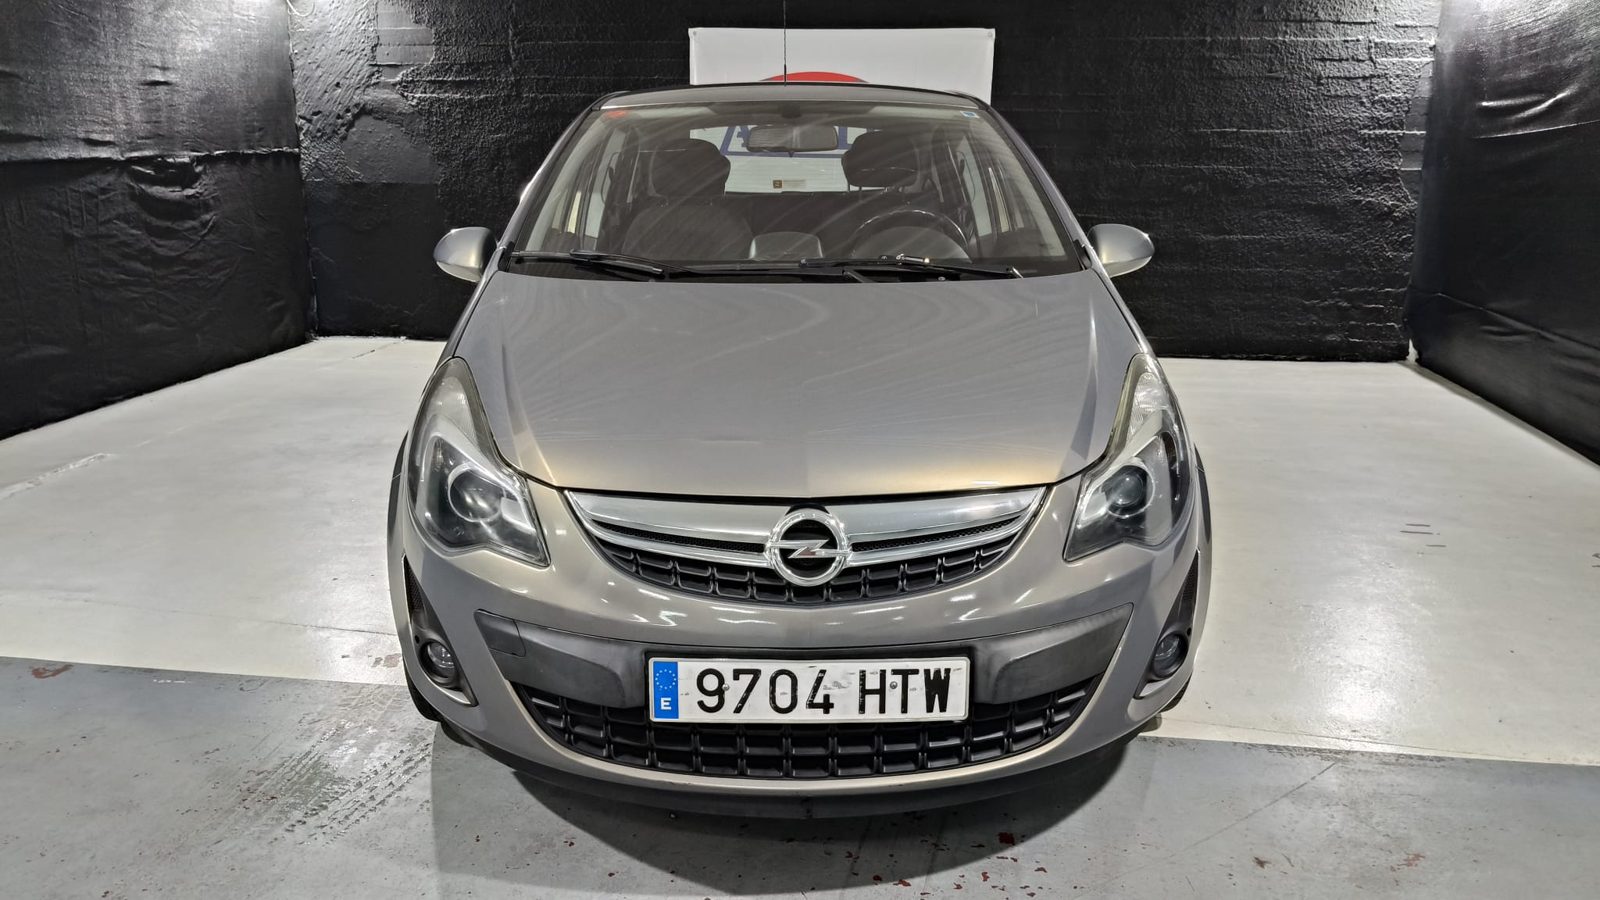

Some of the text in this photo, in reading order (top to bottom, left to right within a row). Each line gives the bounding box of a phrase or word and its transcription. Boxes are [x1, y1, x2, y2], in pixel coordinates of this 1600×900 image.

[660, 697, 672, 710] E
[696, 667, 951, 714] 9704 HTW
